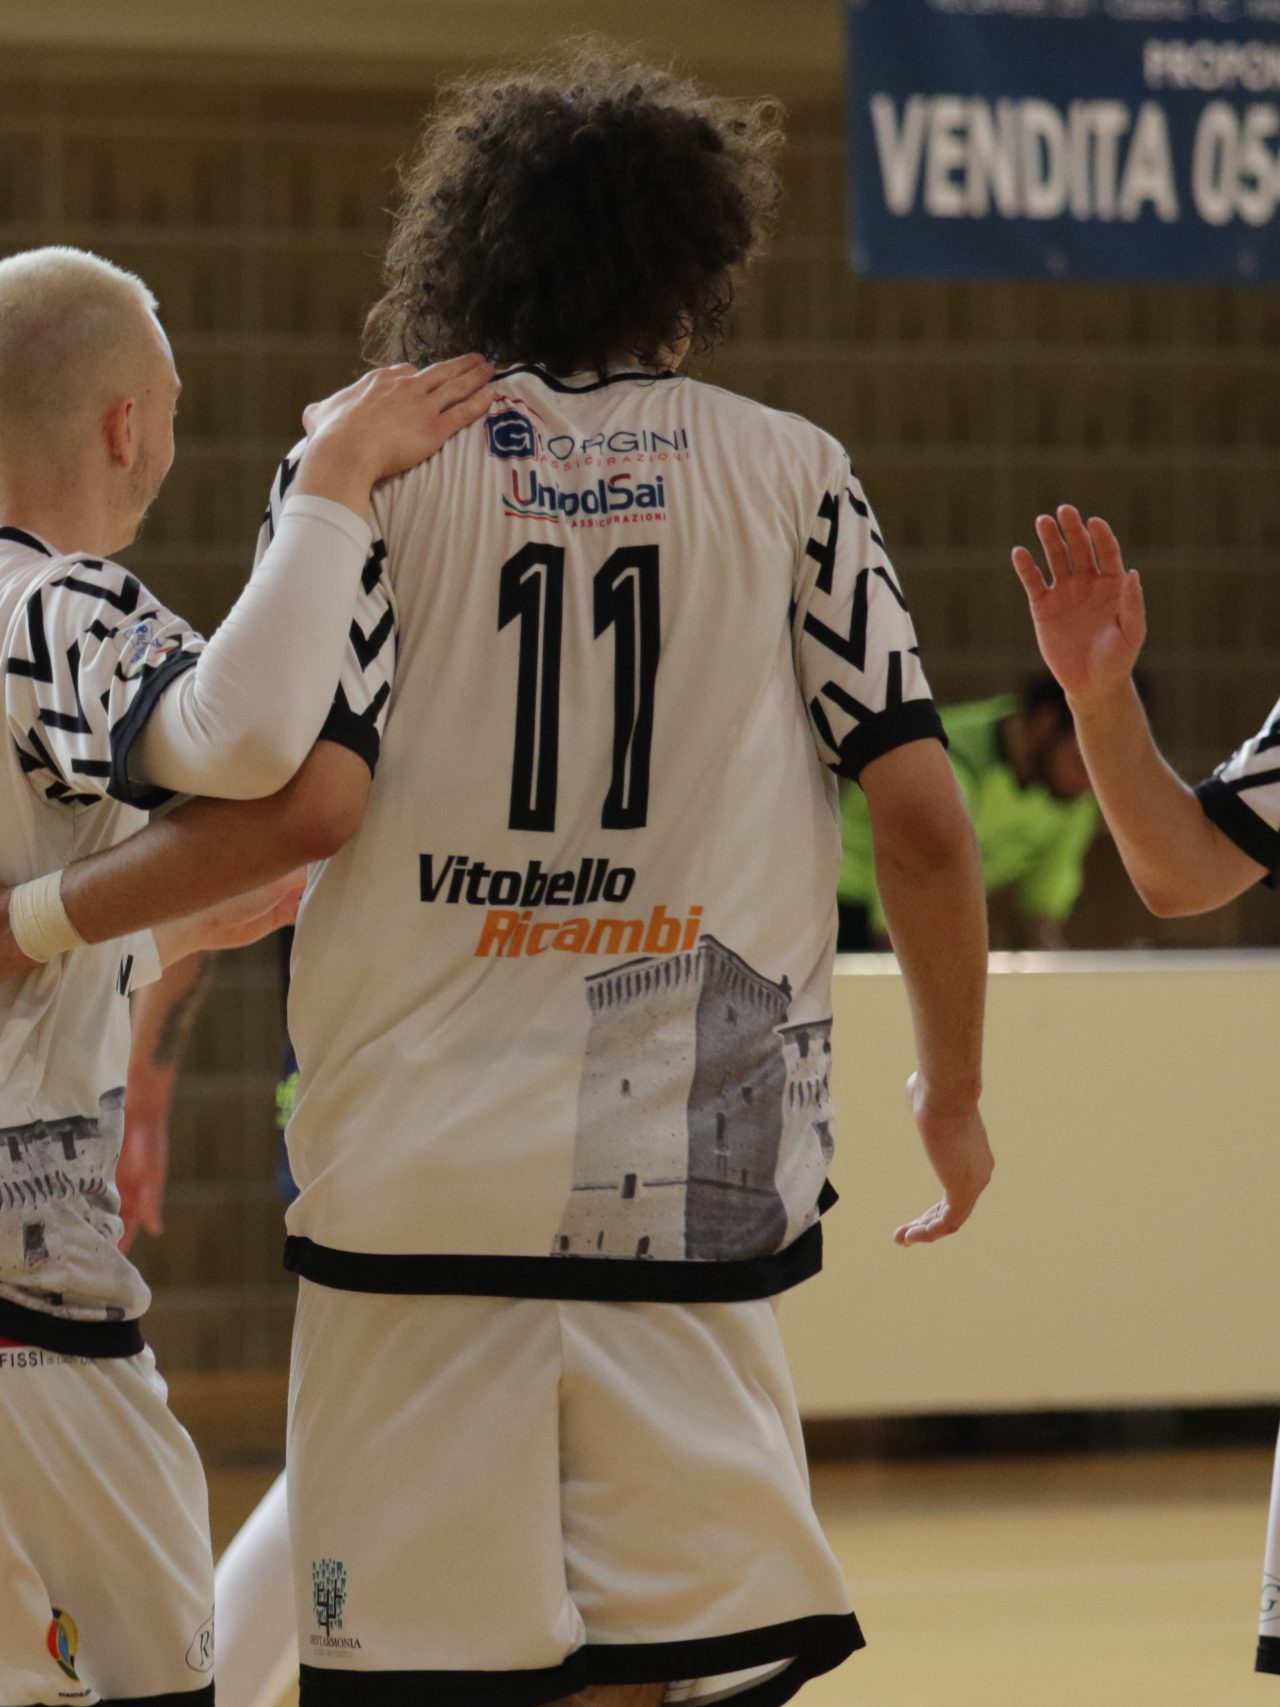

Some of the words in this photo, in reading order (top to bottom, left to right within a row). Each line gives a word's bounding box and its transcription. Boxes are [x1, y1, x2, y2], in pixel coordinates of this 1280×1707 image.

[1143, 39, 1280, 91] PROPO
[869, 94, 1179, 223] VENDITA
[1192, 99, 1280, 227] 05
[572, 513, 666, 528] ASSICURAZIONI
[498, 541, 661, 832] 11
[419, 853, 636, 908] Vitobello
[474, 904, 705, 958] Ricambi
